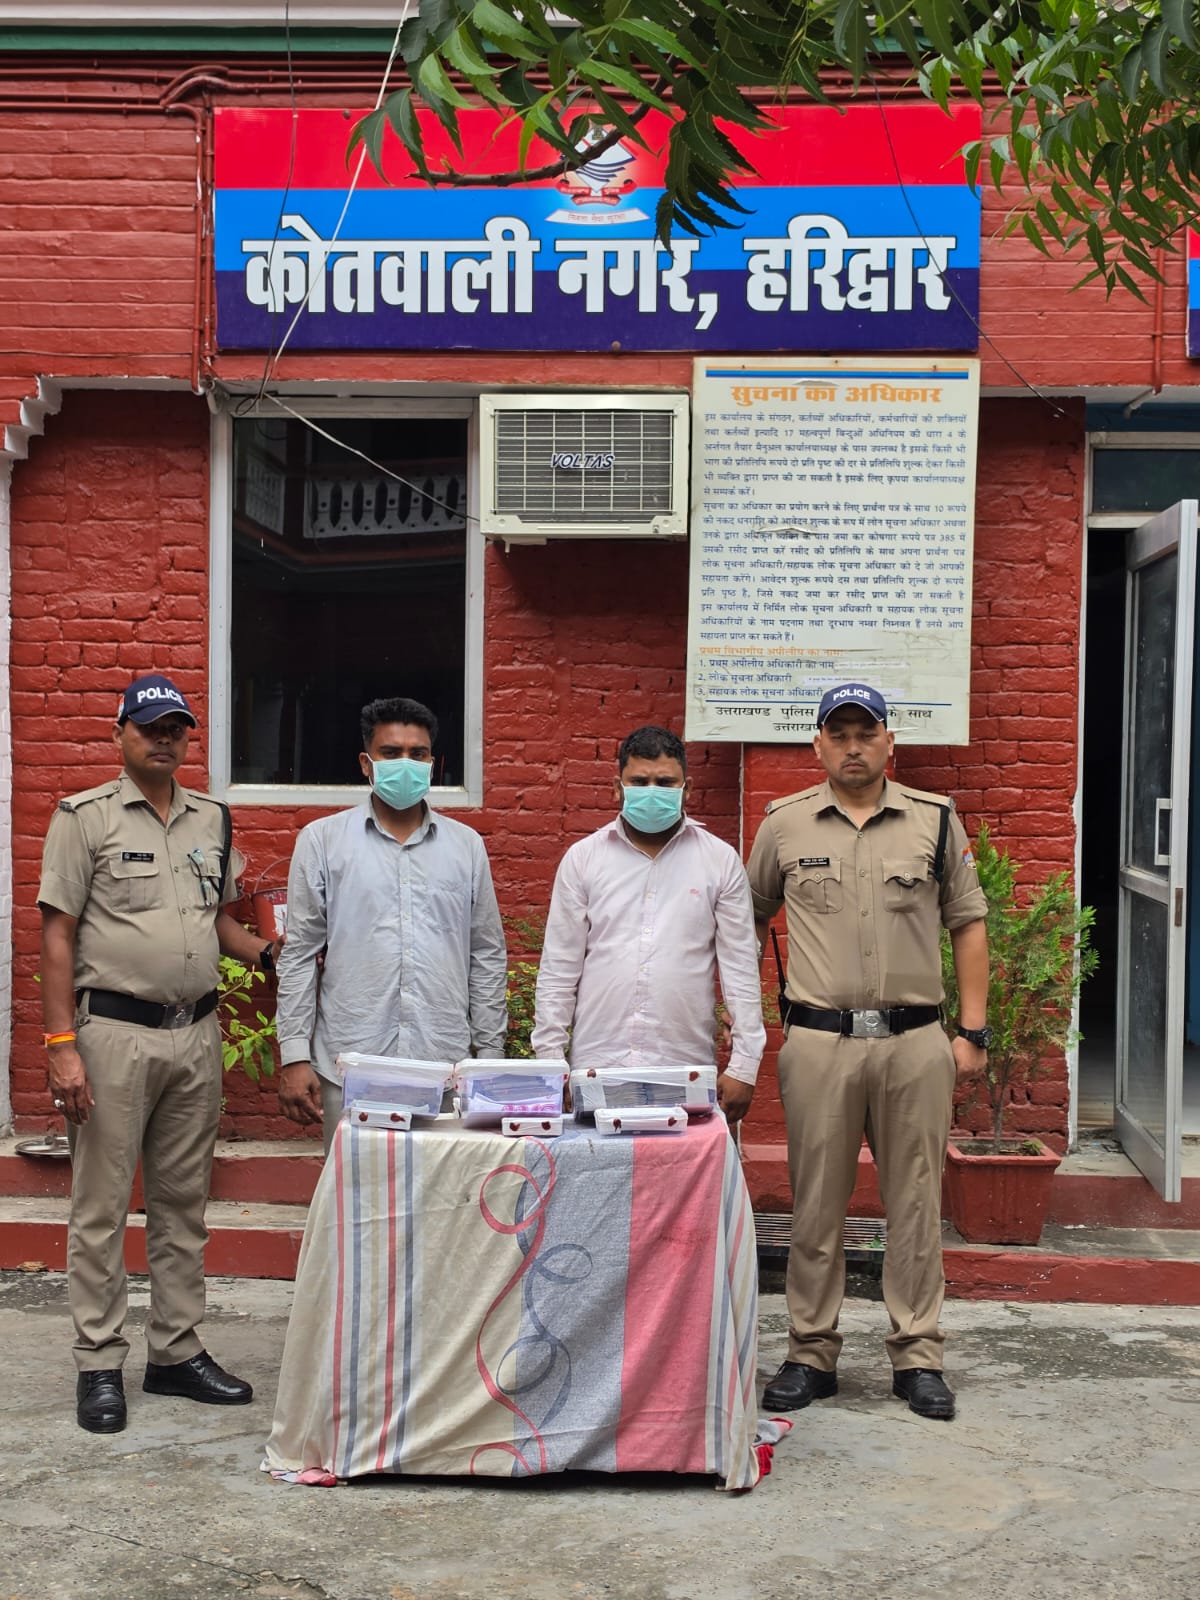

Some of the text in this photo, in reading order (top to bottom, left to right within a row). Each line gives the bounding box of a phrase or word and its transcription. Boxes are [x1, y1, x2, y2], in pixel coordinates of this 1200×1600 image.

[241, 213, 957, 331] कोतवाली नगर, हरिद्वार
[804, 386, 837, 402] का
[845, 383, 943, 403] अधिकार
[551, 453, 615, 469] VOLTAS
[833, 689, 871, 701] POLICE
[715, 706, 772, 717] उत्तराखण्ड
[780, 705, 816, 720] पुलिस
[907, 709, 933, 719] साथ
